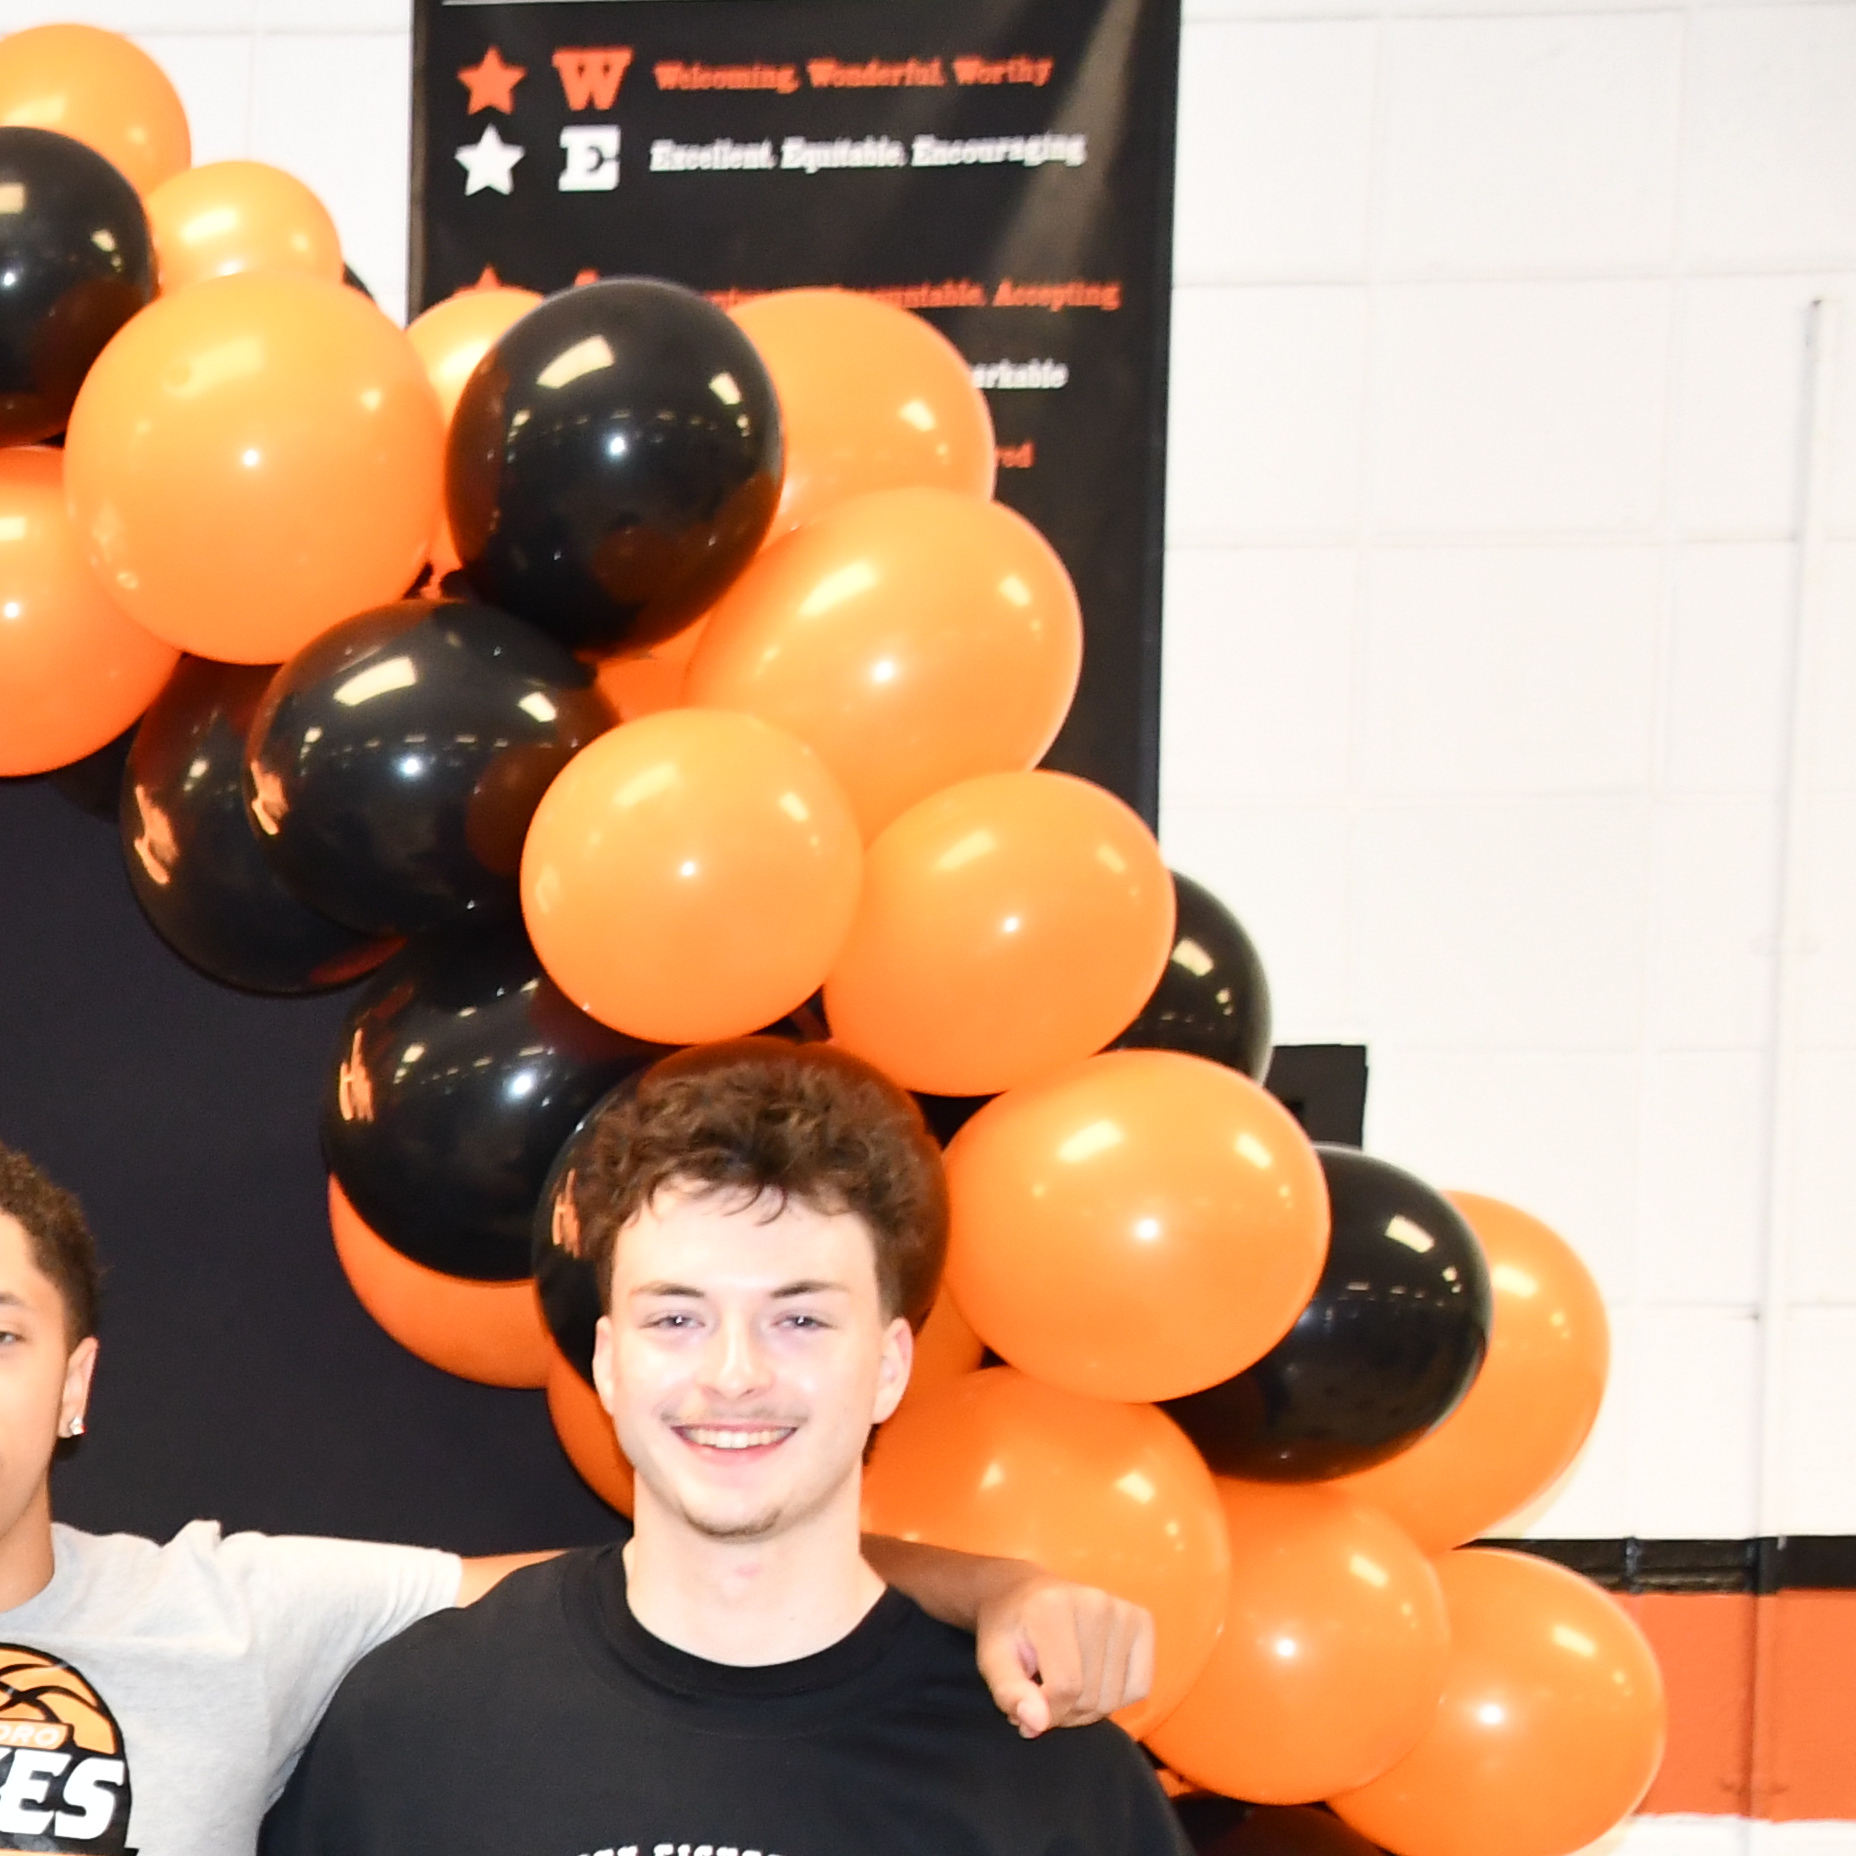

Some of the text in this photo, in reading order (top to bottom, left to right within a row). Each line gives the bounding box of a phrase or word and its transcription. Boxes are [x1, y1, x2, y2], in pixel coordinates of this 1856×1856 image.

[551, 46, 635, 112] W
[952, 54, 1054, 87] Worthy
[558, 124, 621, 192] E
[911, 131, 1088, 167] Encouraging
[992, 277, 1122, 312] Accepting
[972, 357, 1070, 390] arkable
